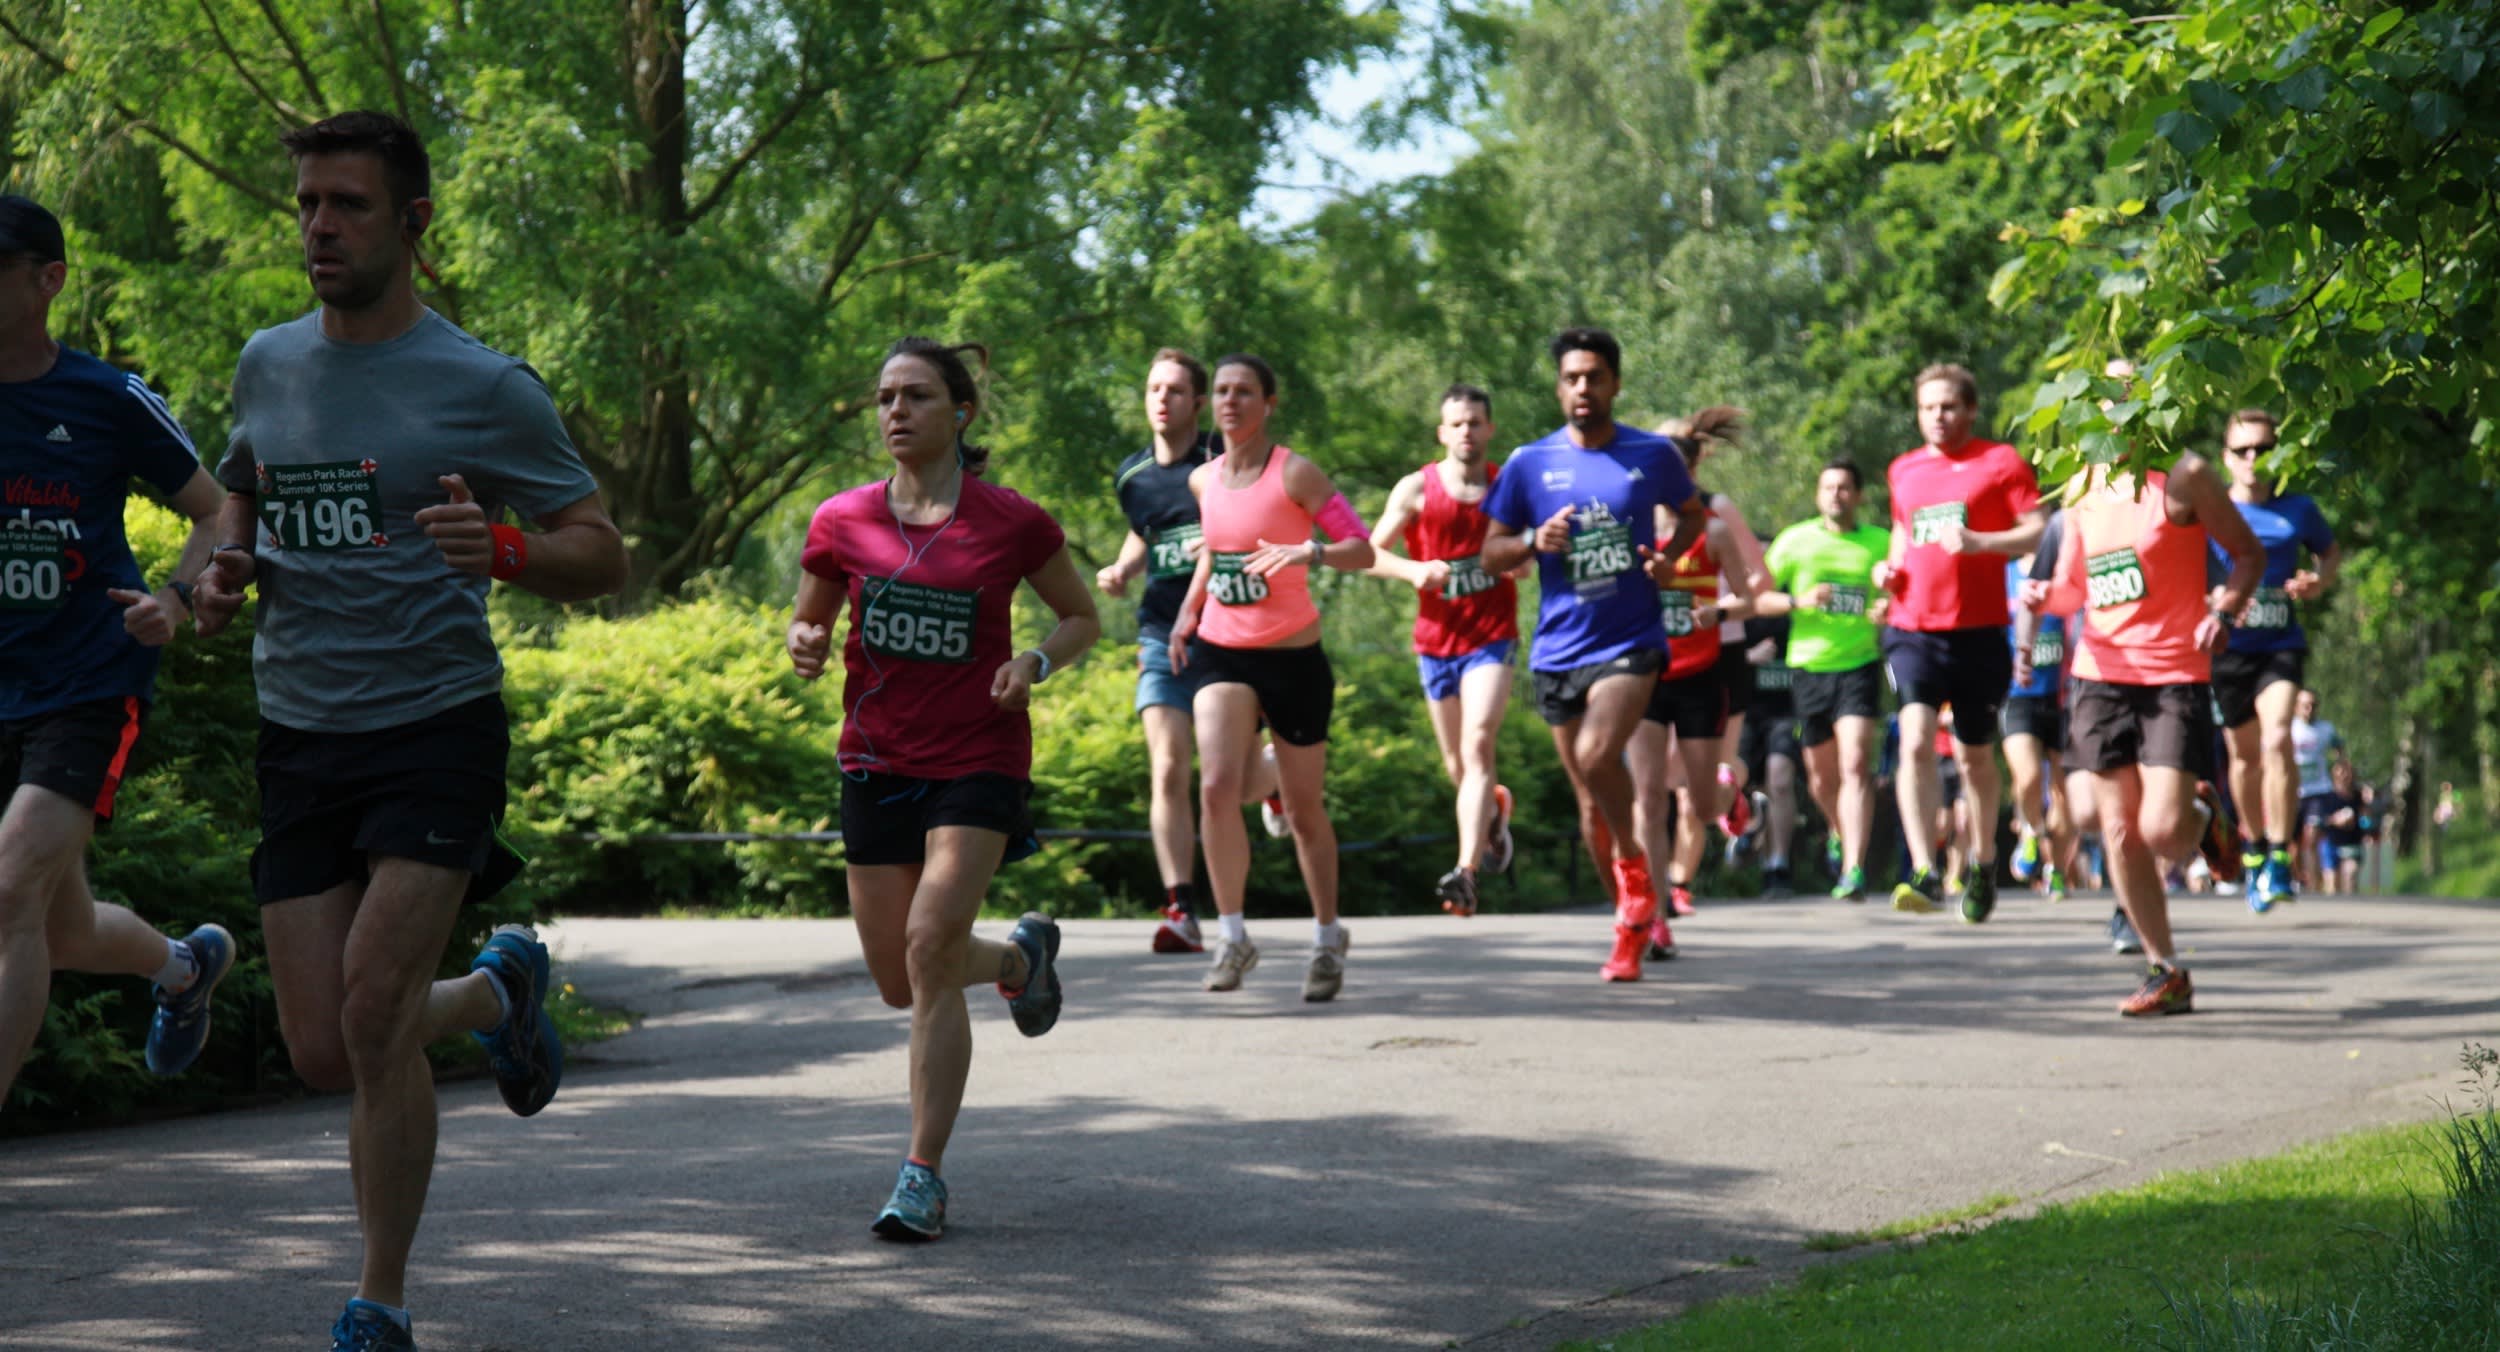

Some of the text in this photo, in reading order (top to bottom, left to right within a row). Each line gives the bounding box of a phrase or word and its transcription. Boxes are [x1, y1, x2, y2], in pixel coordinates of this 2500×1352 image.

[4, 473, 80, 512] Vitality
[276, 471, 312, 483] Regents
[313, 469, 337, 481] Park
[278, 481, 370, 495] Summer 10K Series
[265, 498, 373, 547] 7196
[0, 559, 60, 600] 60
[1567, 543, 1633, 581] 7205
[865, 608, 969, 657] 5955
